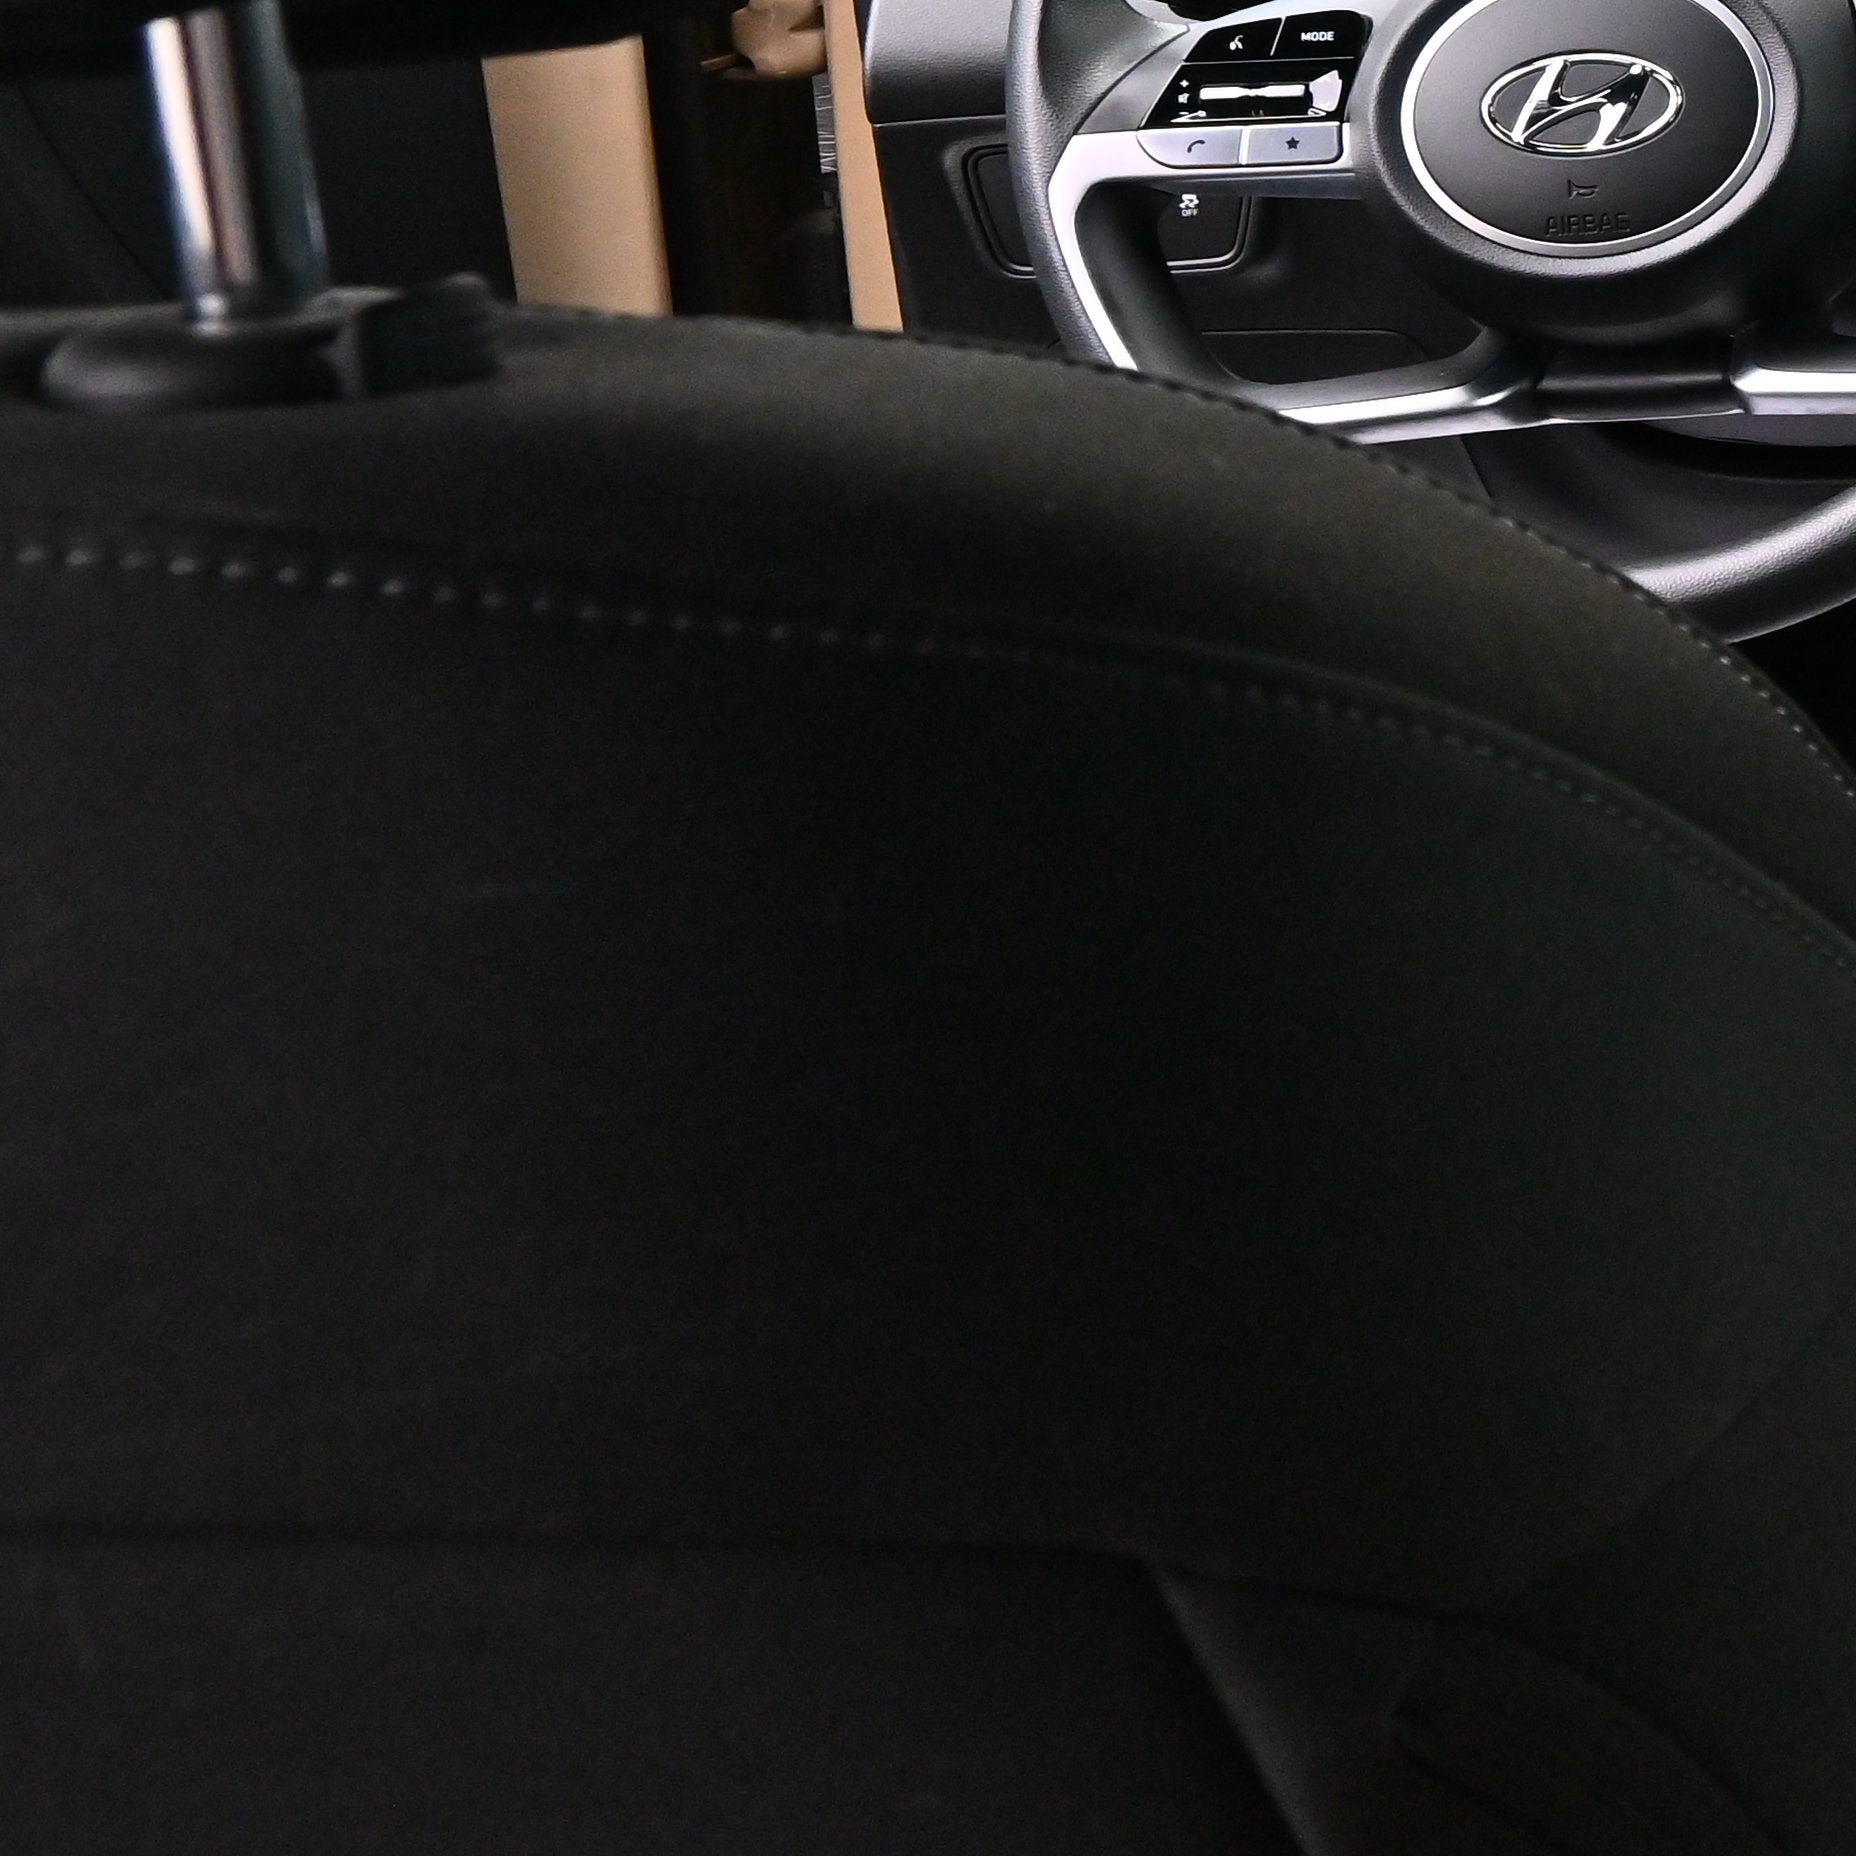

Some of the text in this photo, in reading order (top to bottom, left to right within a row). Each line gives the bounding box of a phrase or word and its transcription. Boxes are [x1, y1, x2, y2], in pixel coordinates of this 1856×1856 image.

[1300, 31, 1335, 42] MODE
[1181, 209, 1198, 218] OFF
[1545, 213, 1632, 237] AIRBAG
